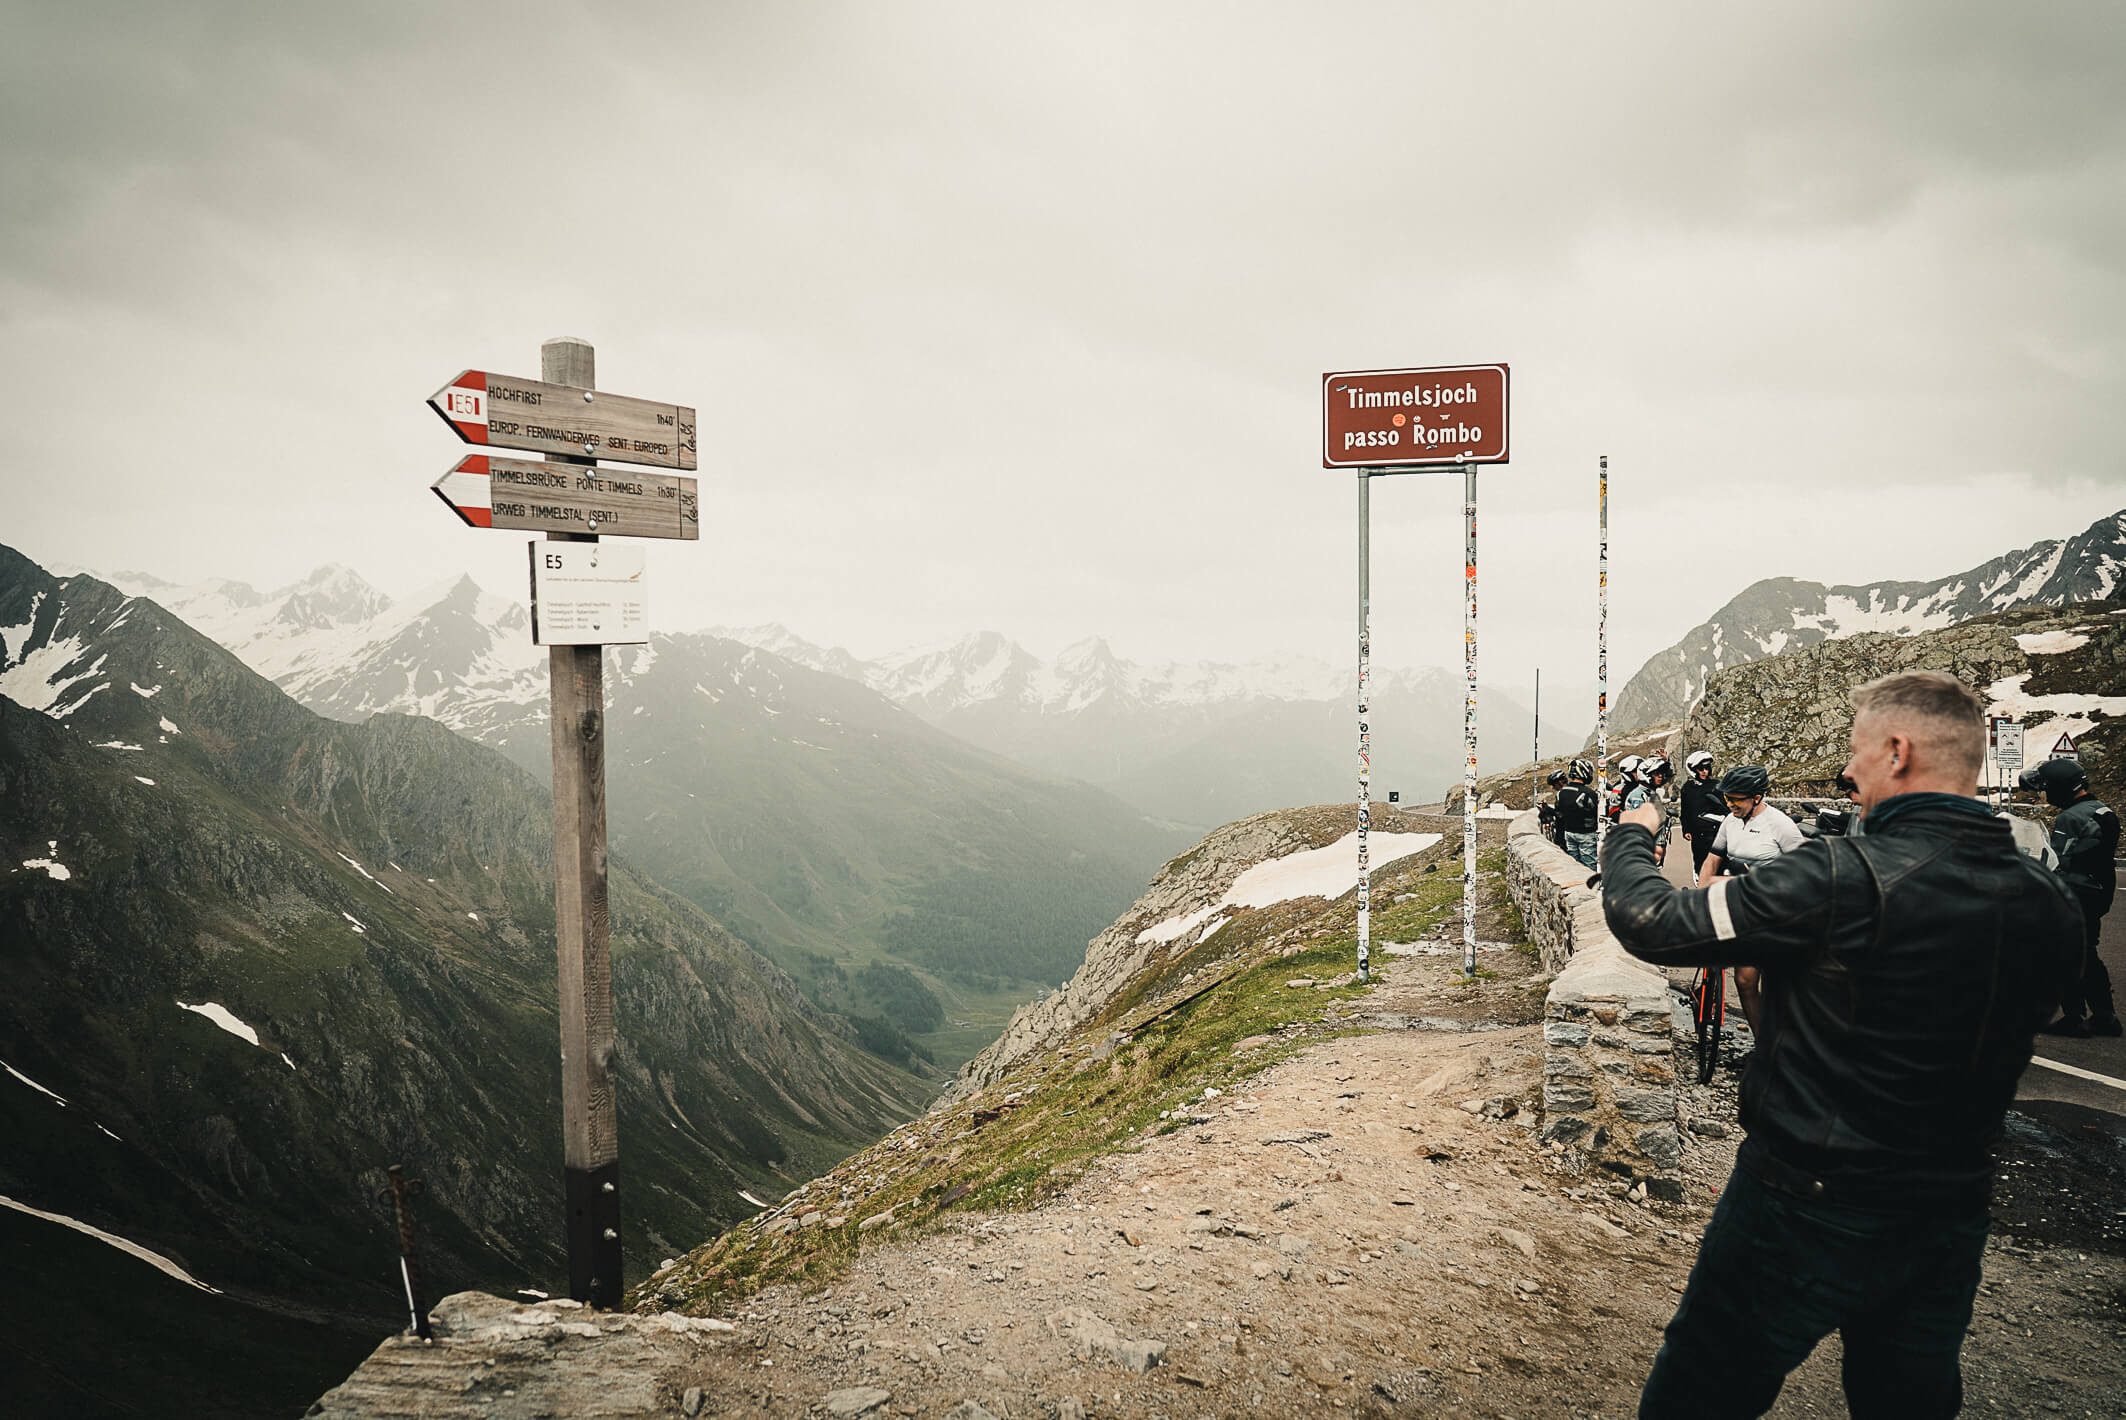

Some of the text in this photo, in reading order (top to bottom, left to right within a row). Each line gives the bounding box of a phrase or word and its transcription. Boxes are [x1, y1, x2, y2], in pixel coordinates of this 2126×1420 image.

[456, 394, 474, 415] E5
[488, 386, 542, 405] HOCHFIRST
[1347, 382, 1477, 409] Timmelsjoch
[489, 420, 668, 455] EUROP. FERNWANDERWEG SENT. EUROPEO
[1344, 422, 1482, 451] passo Rombo
[491, 469, 643, 495] TIMMELSBRÜCKE PONTE TIMMELS
[492, 503, 618, 523] URWEG TIMMELSTAL (SENT.)
[545, 554, 562, 569] E5
